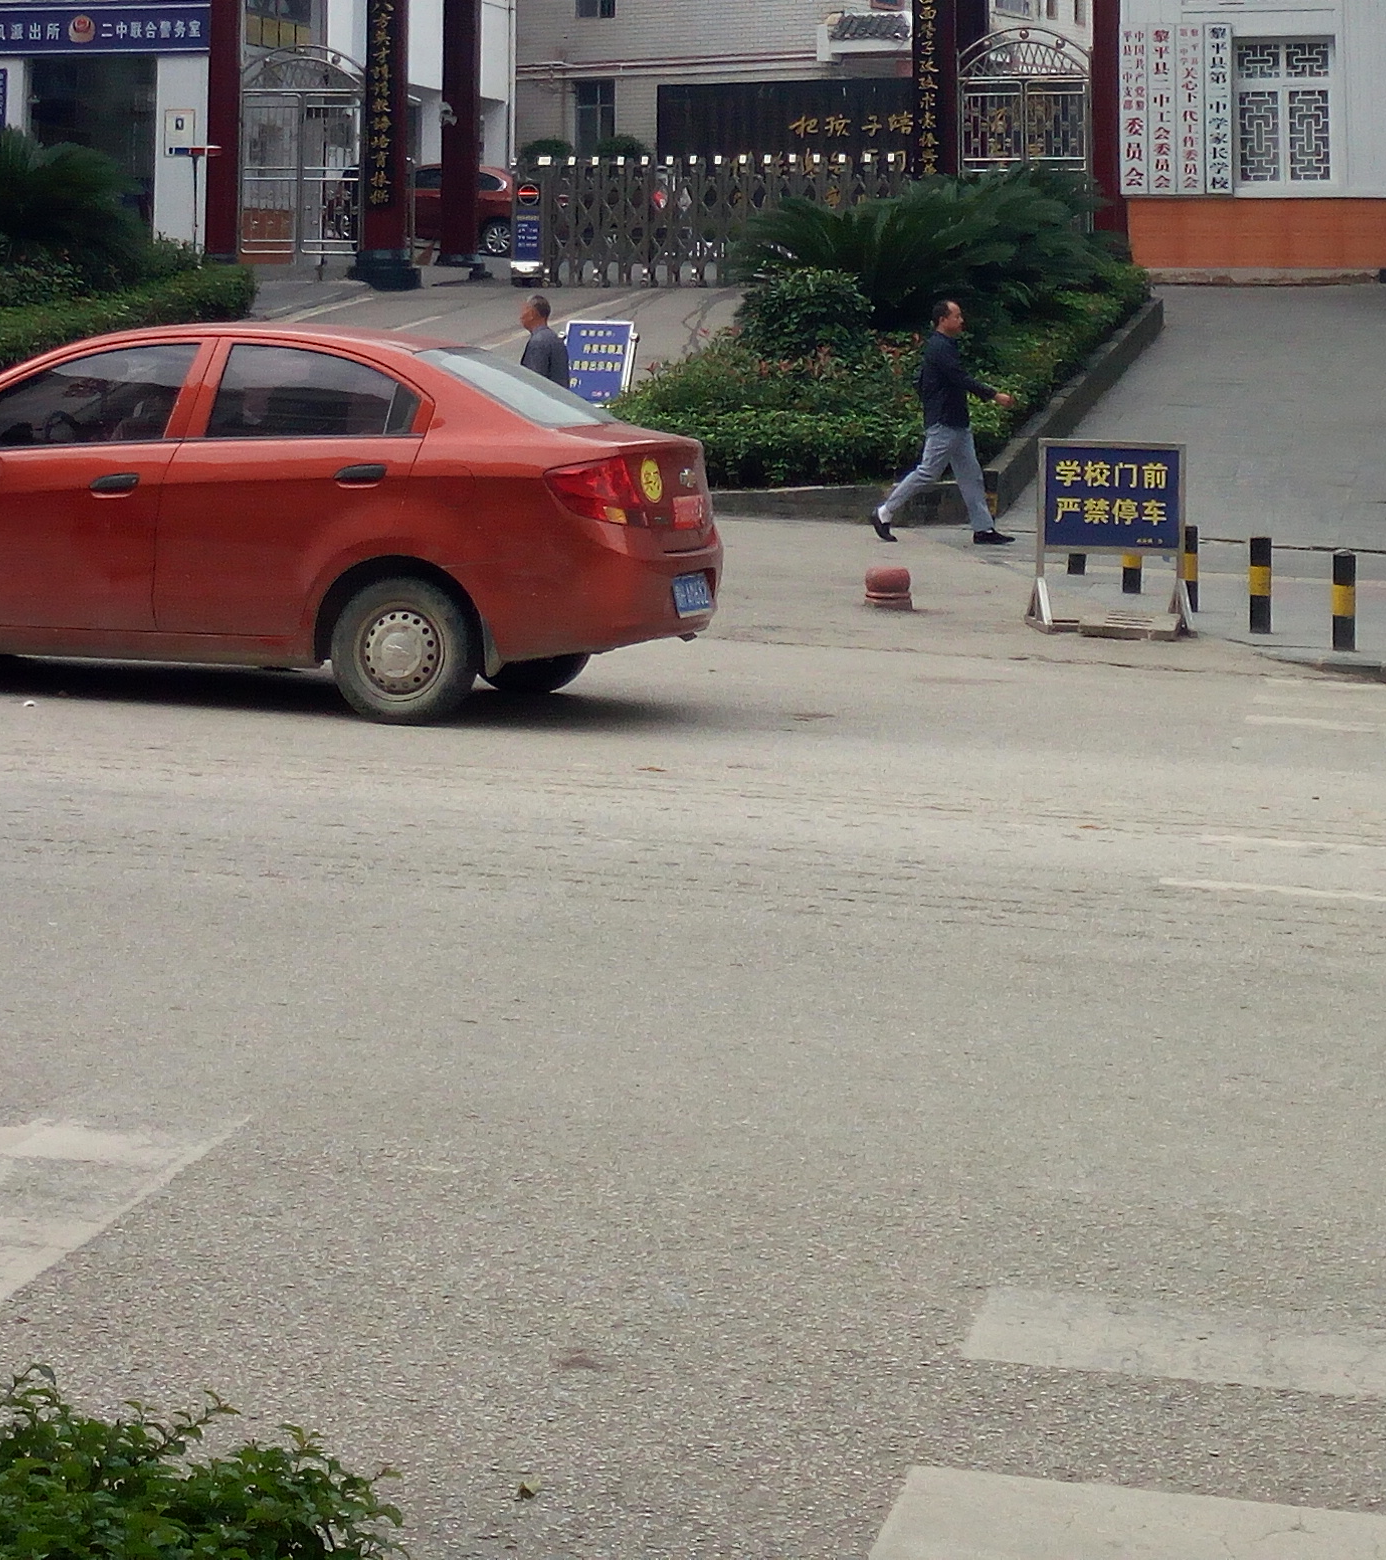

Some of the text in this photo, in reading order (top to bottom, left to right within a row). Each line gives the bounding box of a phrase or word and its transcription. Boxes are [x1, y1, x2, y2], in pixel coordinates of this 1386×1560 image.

[101, 19, 202, 39] 二中联合警务室
[1153, 29, 1171, 188] 黎平县二中工会委员会
[1181, 67, 1198, 189] 关心下一代工作委员会
[1210, 27, 1229, 189] 黎平县第二中学家长学校
[1124, 117, 1144, 187] 委员会
[1055, 460, 1169, 489] 学校门前
[1054, 497, 1167, 526] 严禁停车
